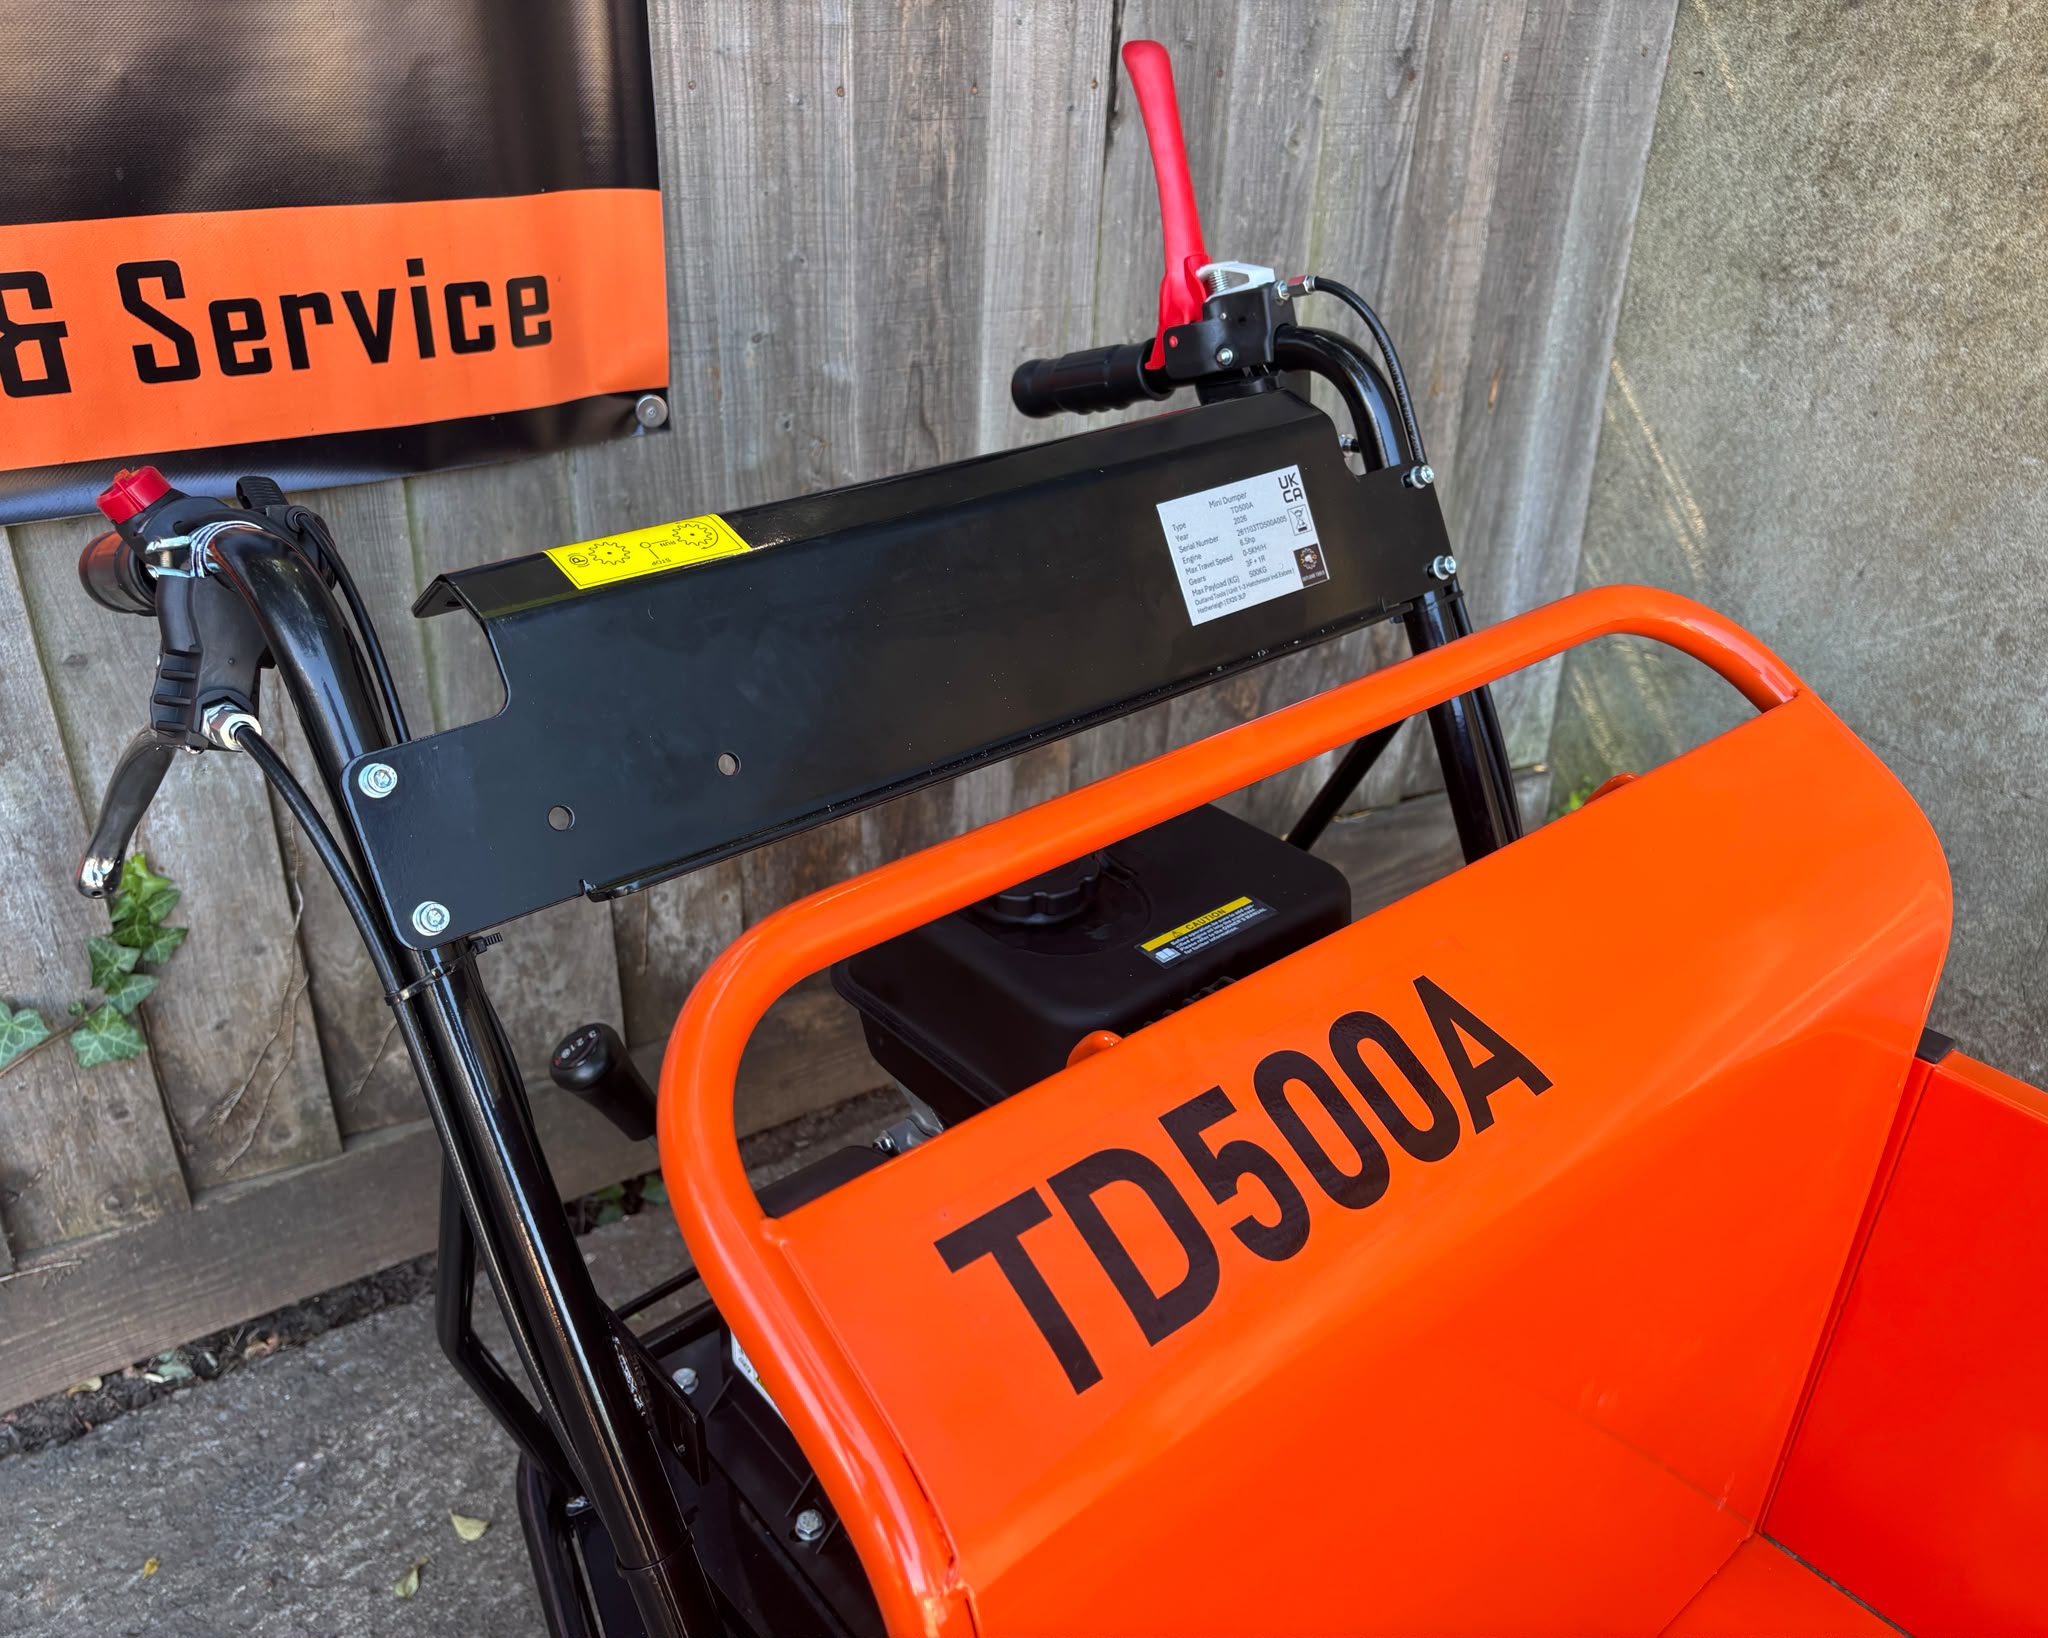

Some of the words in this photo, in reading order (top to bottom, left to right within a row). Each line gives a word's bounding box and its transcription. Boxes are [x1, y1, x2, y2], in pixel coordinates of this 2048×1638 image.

[0, 271, 72, 398] &
[116, 258, 553, 384] Service
[1278, 472, 1299, 489] UK
[1208, 498, 1222, 508] Mini
[1222, 492, 1247, 504] Dumper
[1283, 487, 1303, 503] CA
[1172, 523, 1186, 532] Type
[1230, 502, 1254, 514] TD500A
[1175, 533, 1189, 542] Year
[1233, 515, 1247, 525] 2026
[1178, 542, 1196, 553] Serial
[1195, 536, 1218, 548] Number
[651, 557, 672, 566] STOP
[1182, 554, 1202, 564] Engine
[1185, 567, 1198, 575] Max
[1197, 560, 1216, 571] Travel
[1215, 554, 1234, 566] Speed
[1242, 544, 1267, 556] 0-5KM/H
[1188, 576, 1206, 586] Gears
[1245, 559, 1253, 567] 3F
[1258, 555, 1265, 563] 1R
[1192, 588, 1204, 597] Max
[1204, 579, 1227, 592] Payload
[1227, 575, 1240, 586] (KG)
[1249, 566, 1267, 578] 500KG
[1185, 909, 1226, 930] CAUTION
[934, 975, 1553, 1395] TD500A
